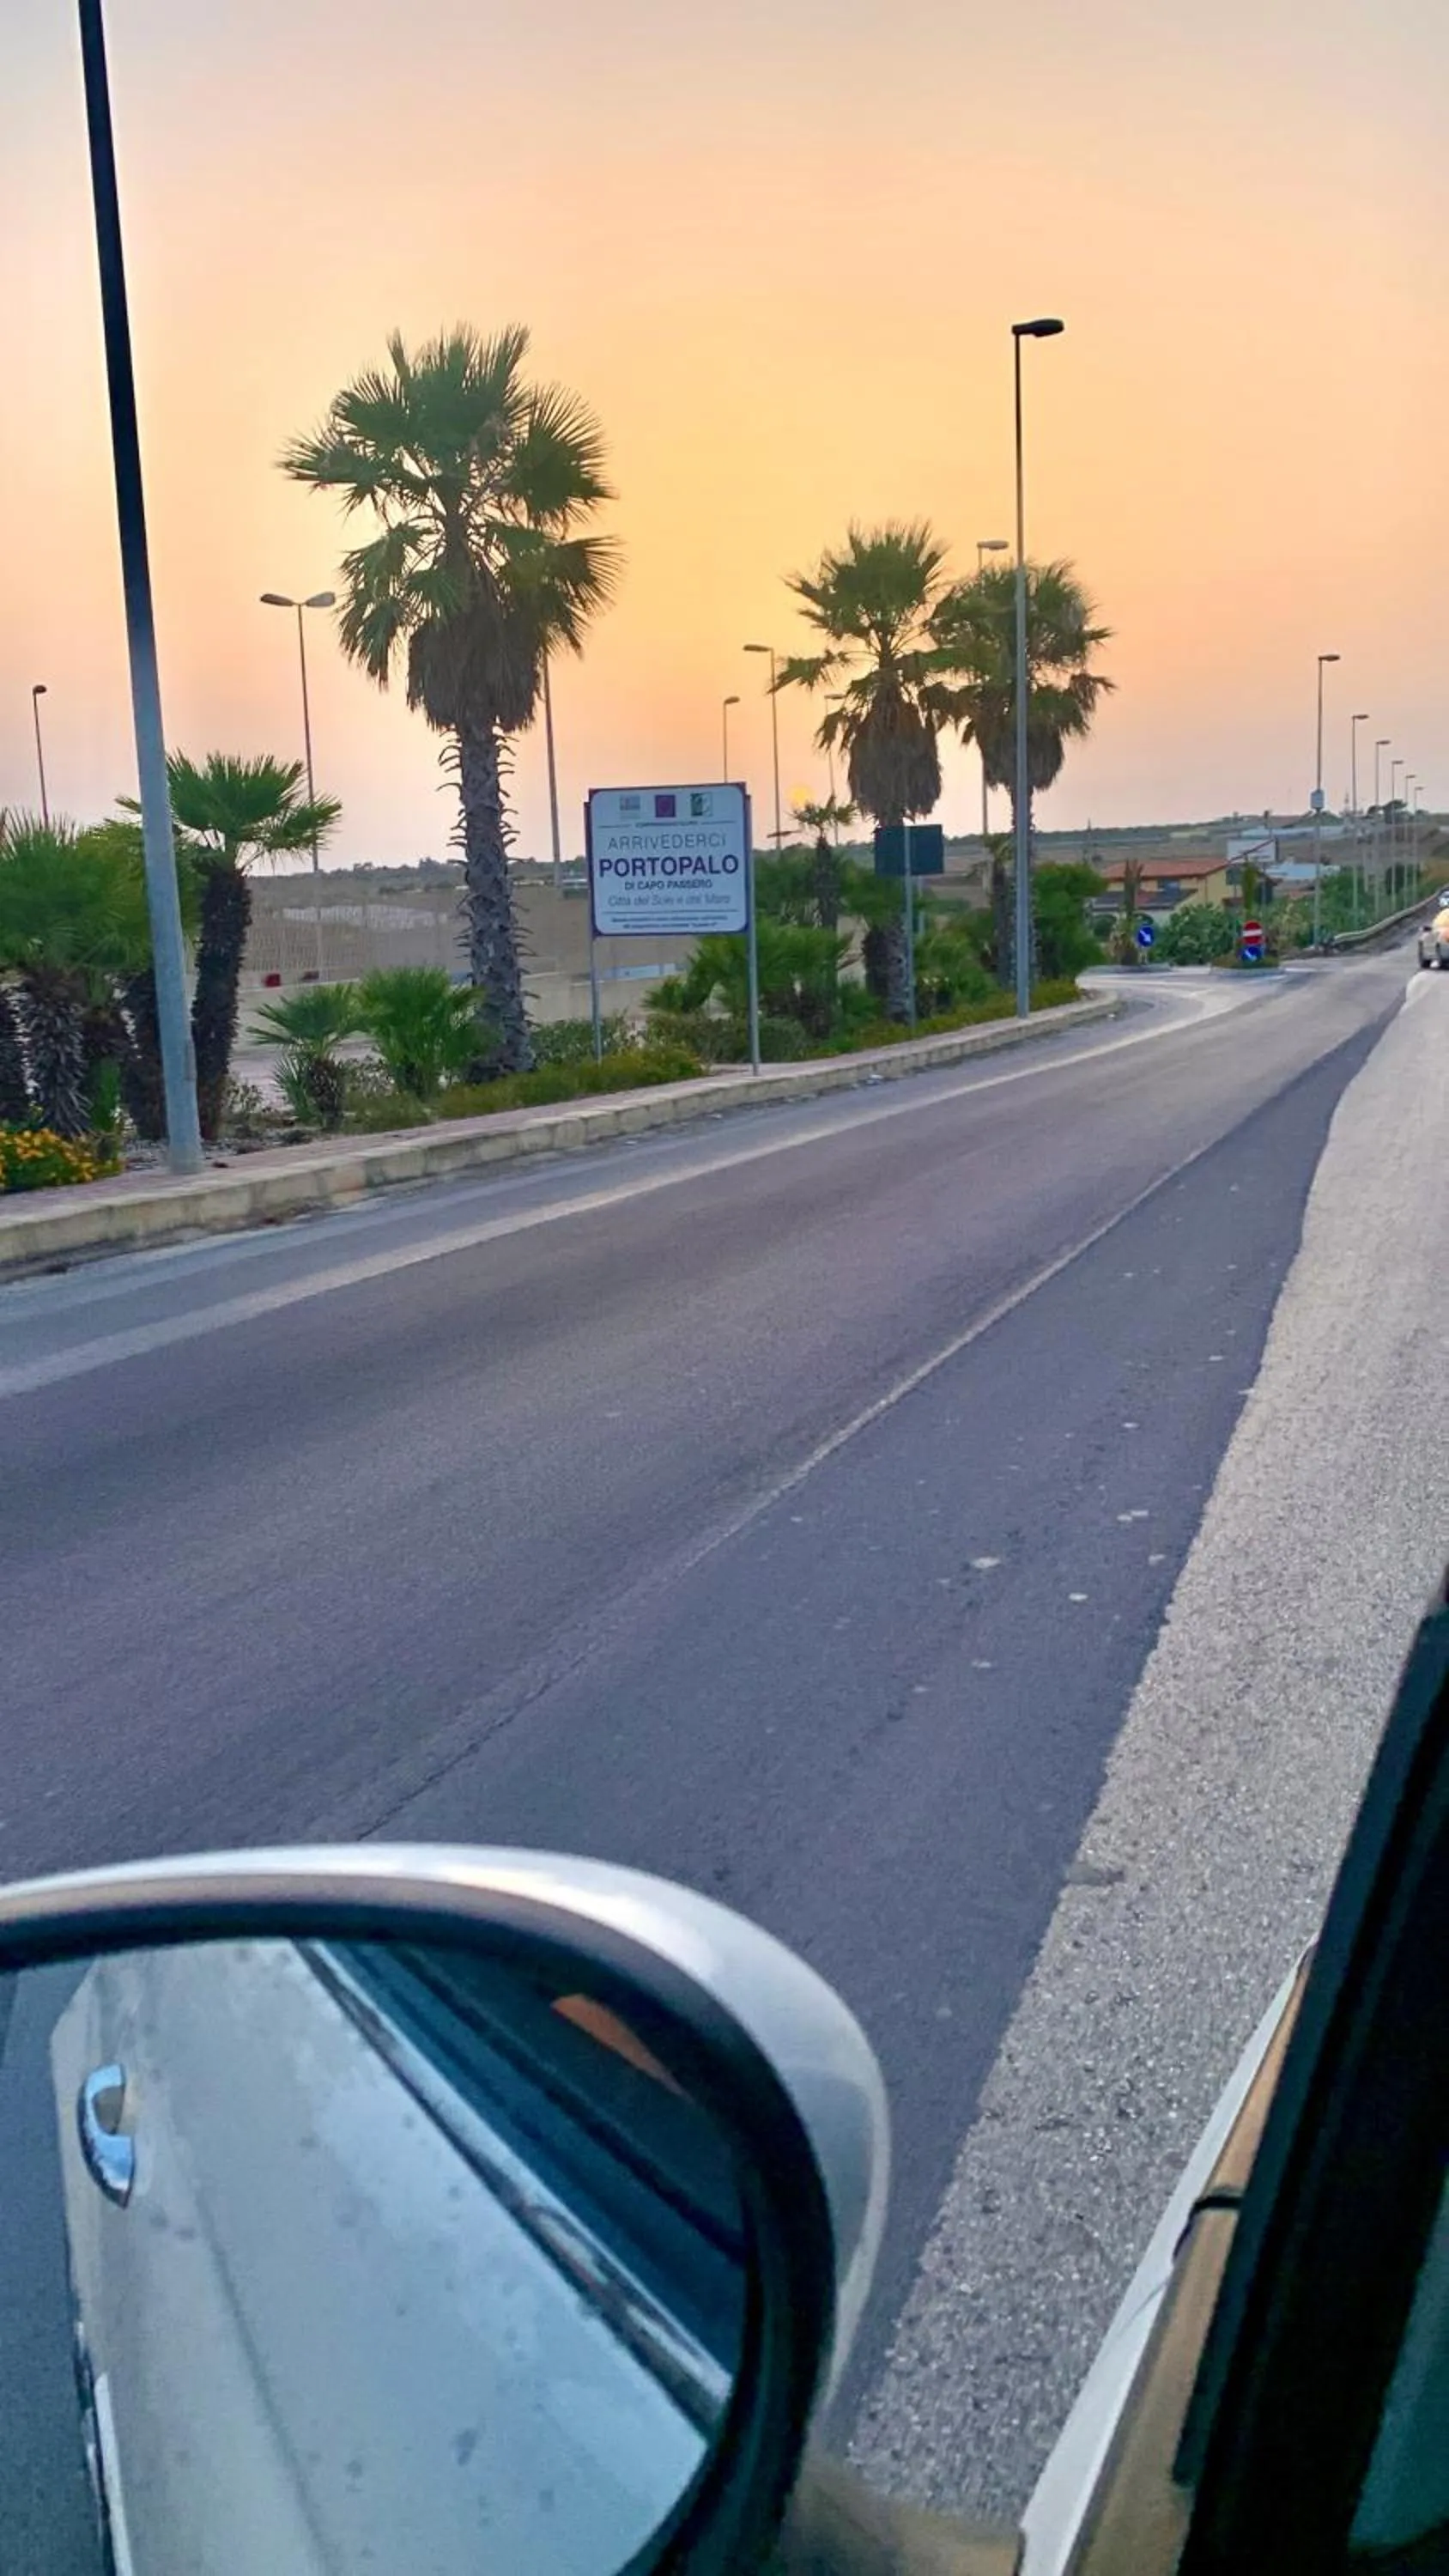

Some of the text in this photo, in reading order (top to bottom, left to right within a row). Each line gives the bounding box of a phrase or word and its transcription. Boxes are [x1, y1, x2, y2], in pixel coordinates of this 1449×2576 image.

[607, 833, 726, 850] ARRIVEDERCI
[599, 854, 739, 878] PORTOPALO
[625, 878, 713, 890] DI CAPO PASSERO
